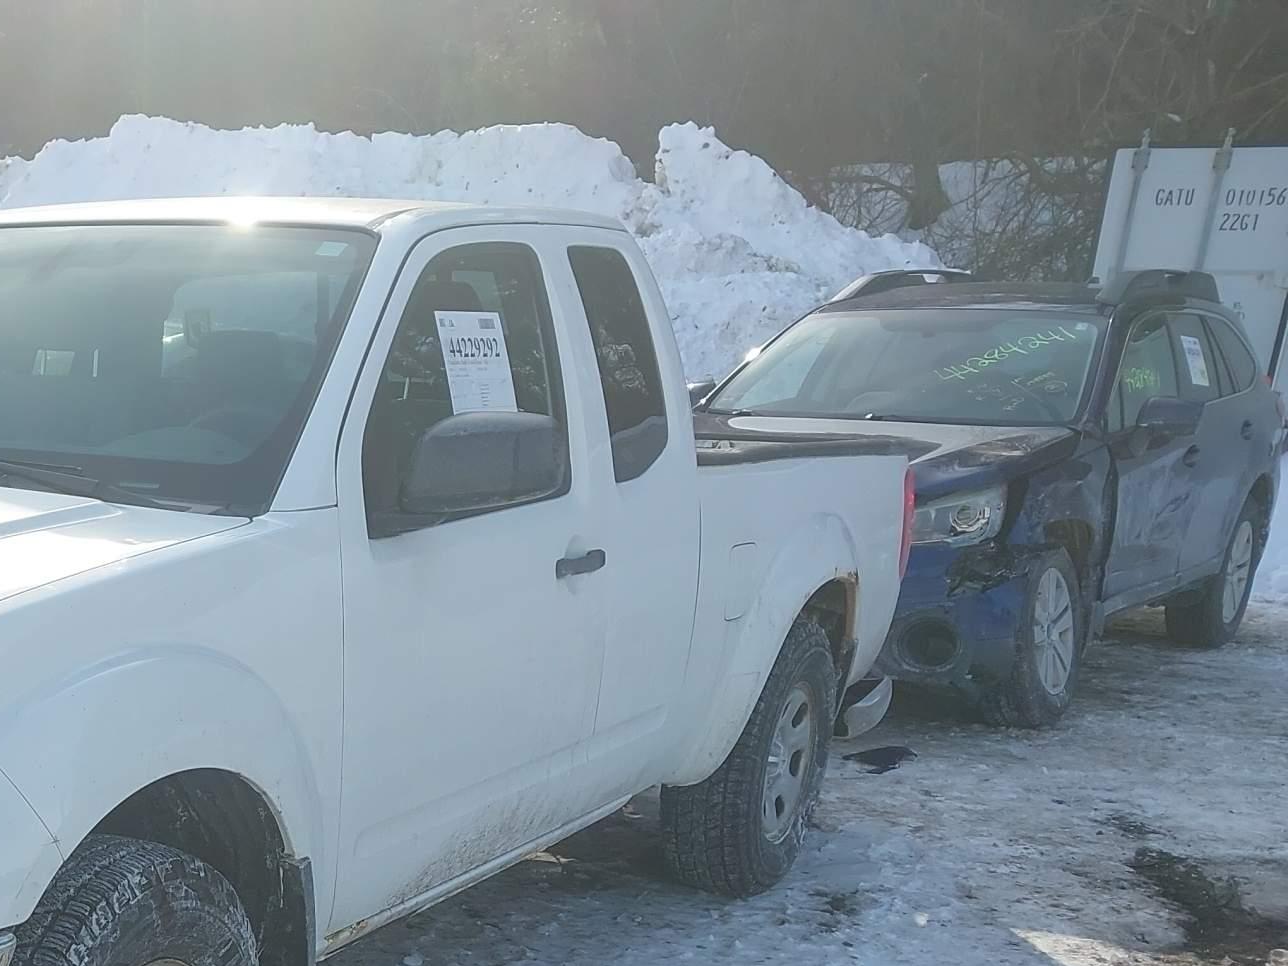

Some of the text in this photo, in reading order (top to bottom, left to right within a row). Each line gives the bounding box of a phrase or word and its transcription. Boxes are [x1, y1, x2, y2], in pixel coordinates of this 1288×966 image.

[1155, 187, 1195, 206] GATU
[1218, 213, 1259, 231] 22G1
[449, 336, 501, 358] 44229292
[933, 326, 1076, 380] 44284241
